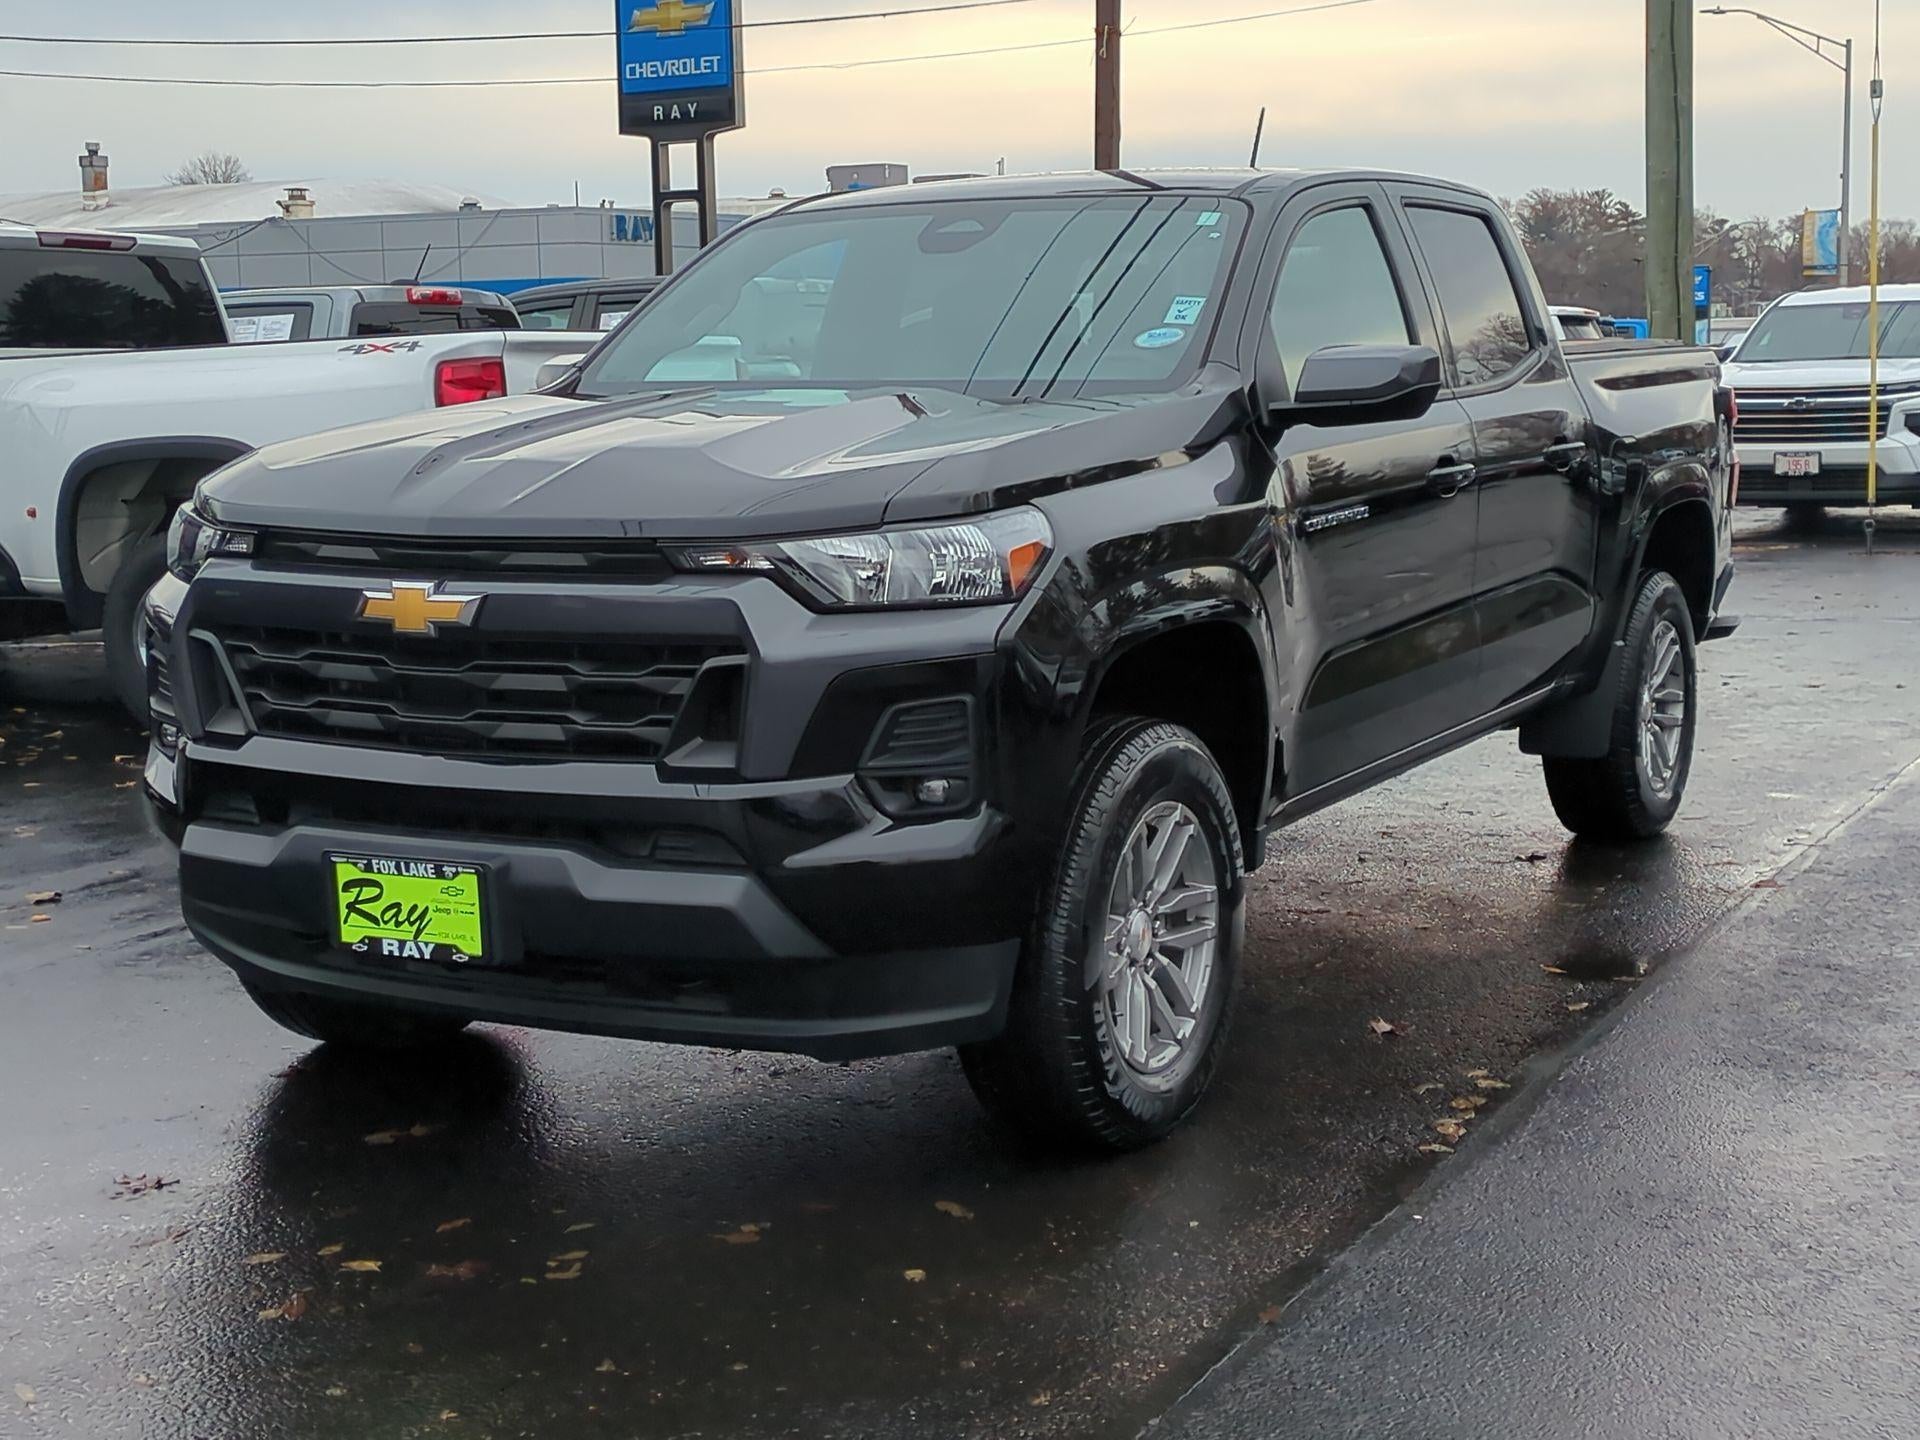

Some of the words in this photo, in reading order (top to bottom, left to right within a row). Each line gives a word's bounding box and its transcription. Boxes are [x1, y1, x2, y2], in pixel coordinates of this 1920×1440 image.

[626, 56, 721, 80] CHEVROLET
[653, 102, 698, 121] RAY
[614, 214, 654, 242] RAY
[371, 859, 399, 875] FOX
[401, 861, 437, 878] LAKE
[341, 877, 433, 941] Ray
[381, 938, 437, 960] RAY
